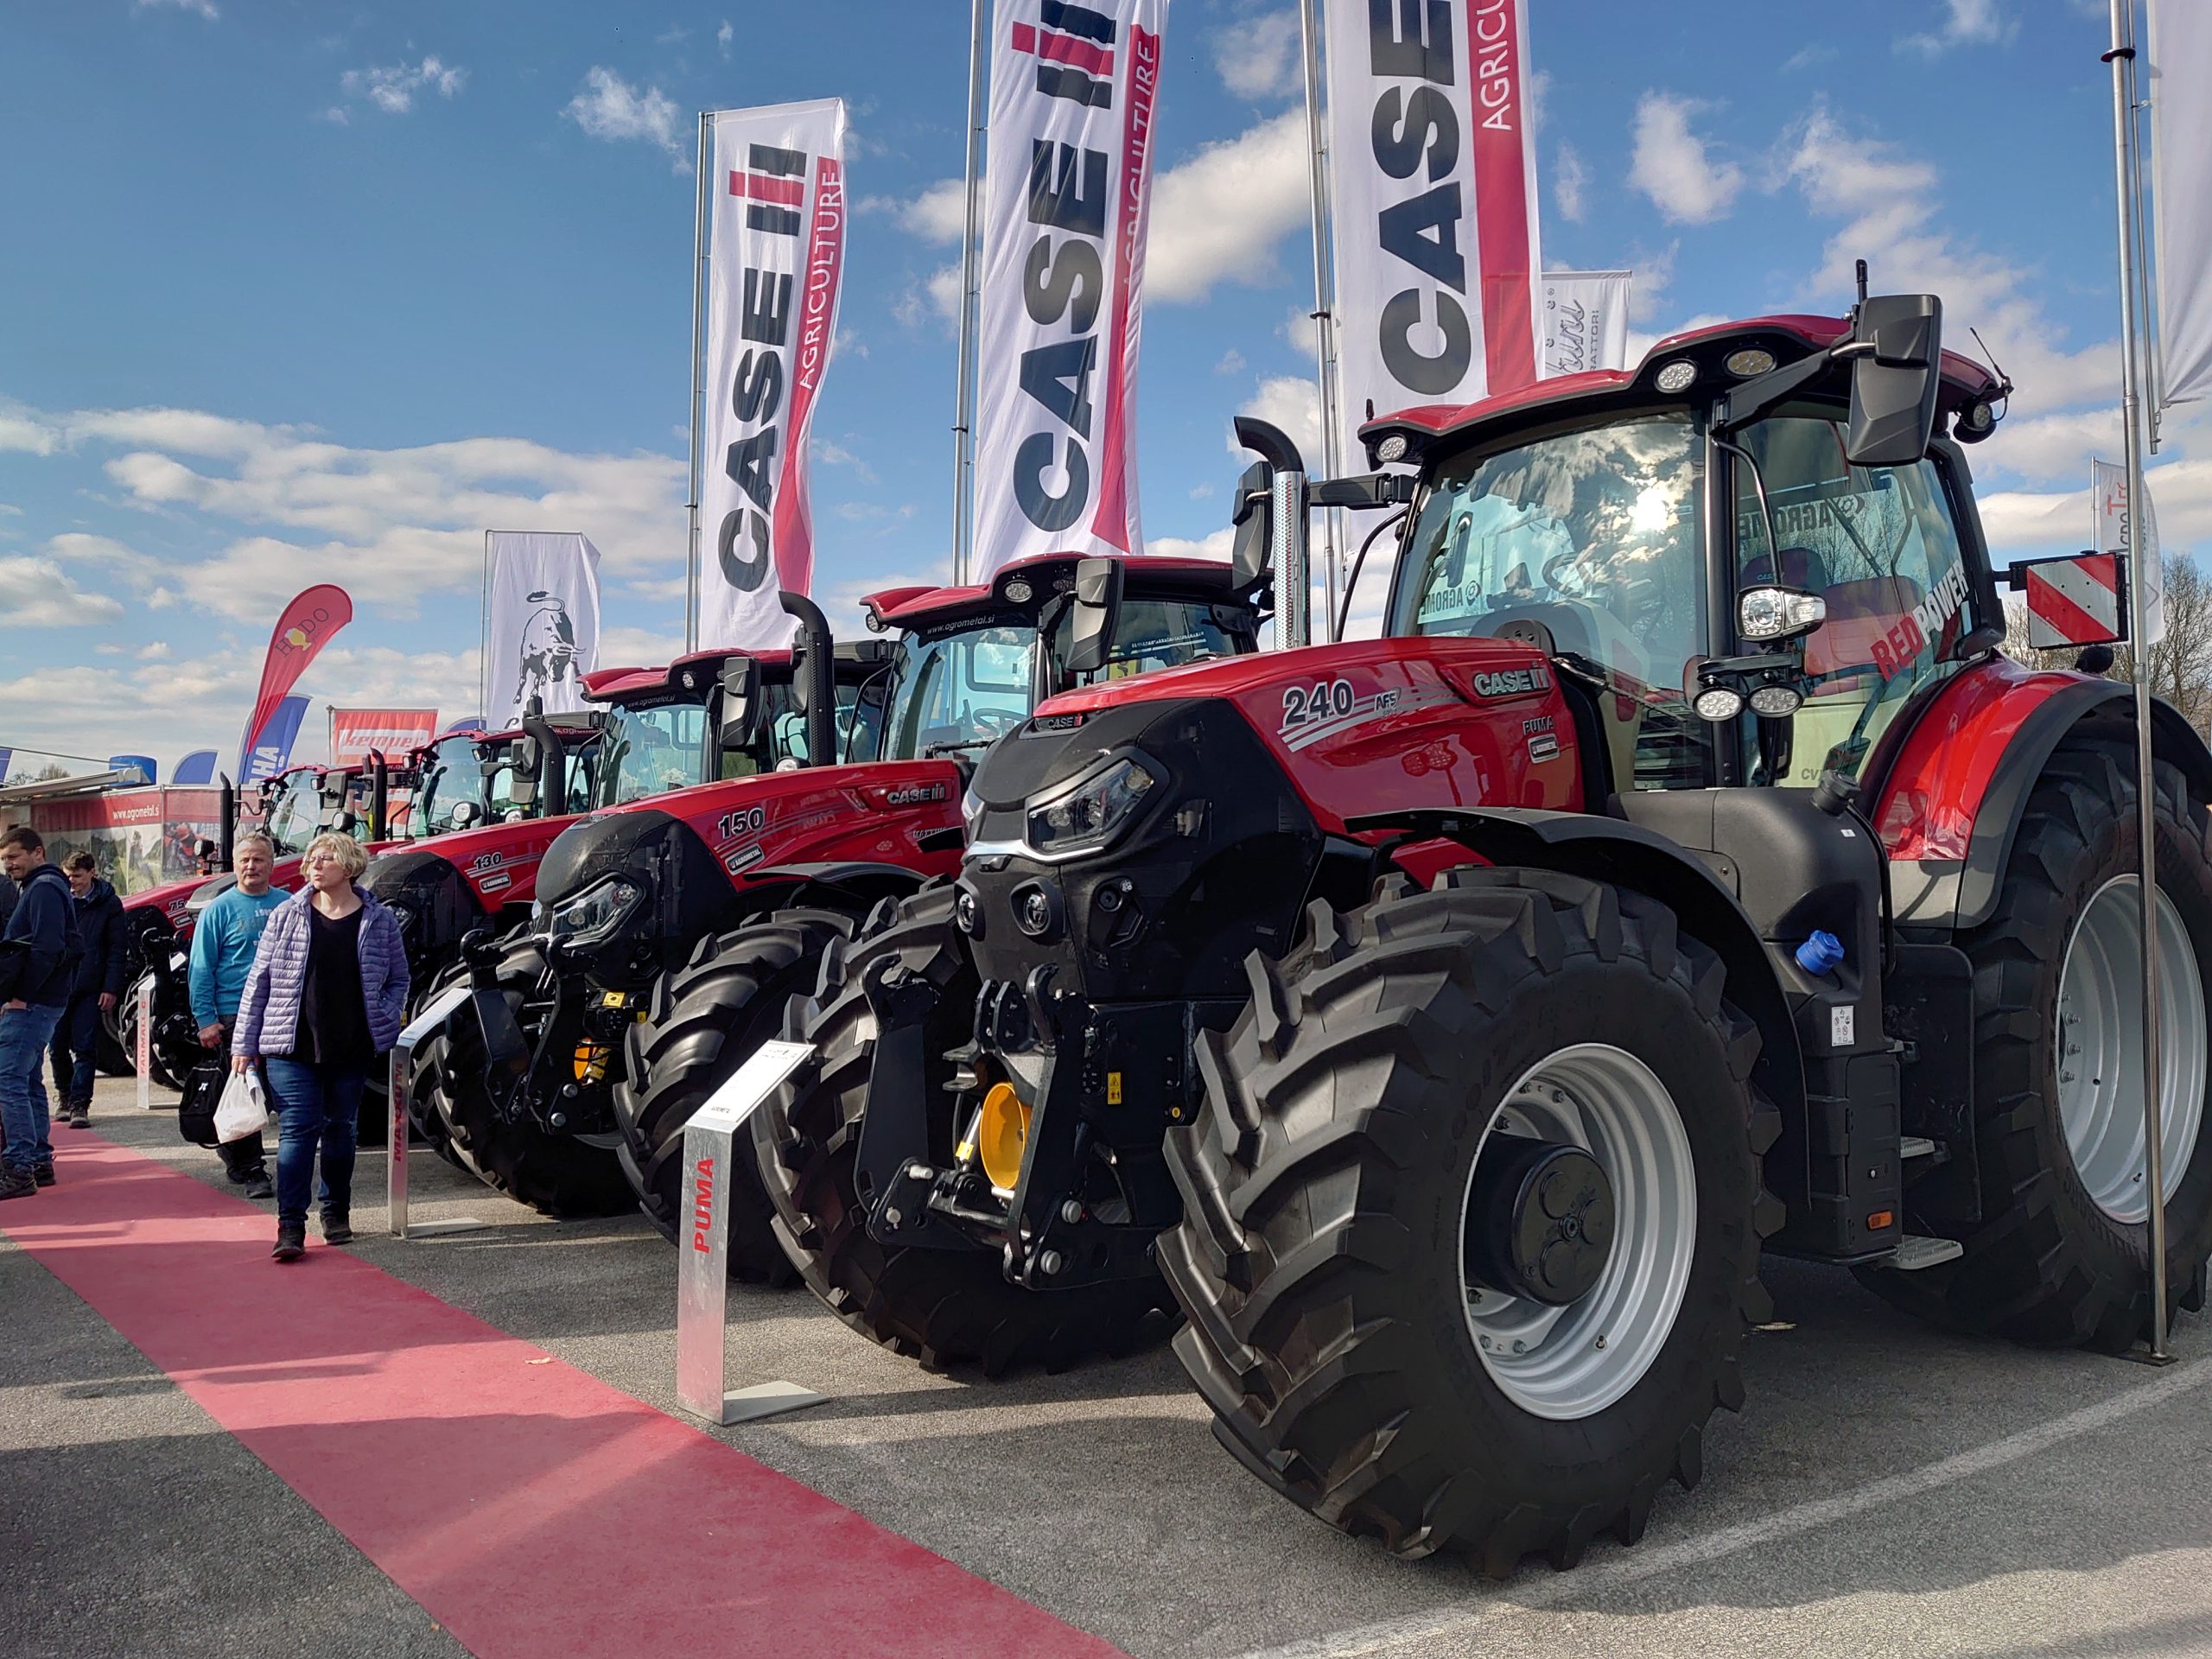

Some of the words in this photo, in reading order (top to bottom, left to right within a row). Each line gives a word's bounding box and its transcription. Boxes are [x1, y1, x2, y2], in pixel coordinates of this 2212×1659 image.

[1370, 0, 1471, 395] CASE
[799, 171, 842, 390] AGRICULTURE
[1013, 138, 1108, 532] CASE
[718, 267, 796, 593] CASE
[927, 614, 995, 634] www.agrometal.si
[1474, 671, 1532, 696] CASE
[627, 694, 675, 709] www.agrometal.si
[1282, 678, 1355, 728] 240
[1374, 690, 1398, 712] AFS
[1048, 717, 1073, 728] CASE
[1522, 715, 1554, 735] PUMA
[887, 788, 930, 804] CASE
[719, 808, 765, 839] 150
[474, 852, 502, 870] 130
[693, 1158, 714, 1254] PUMA
